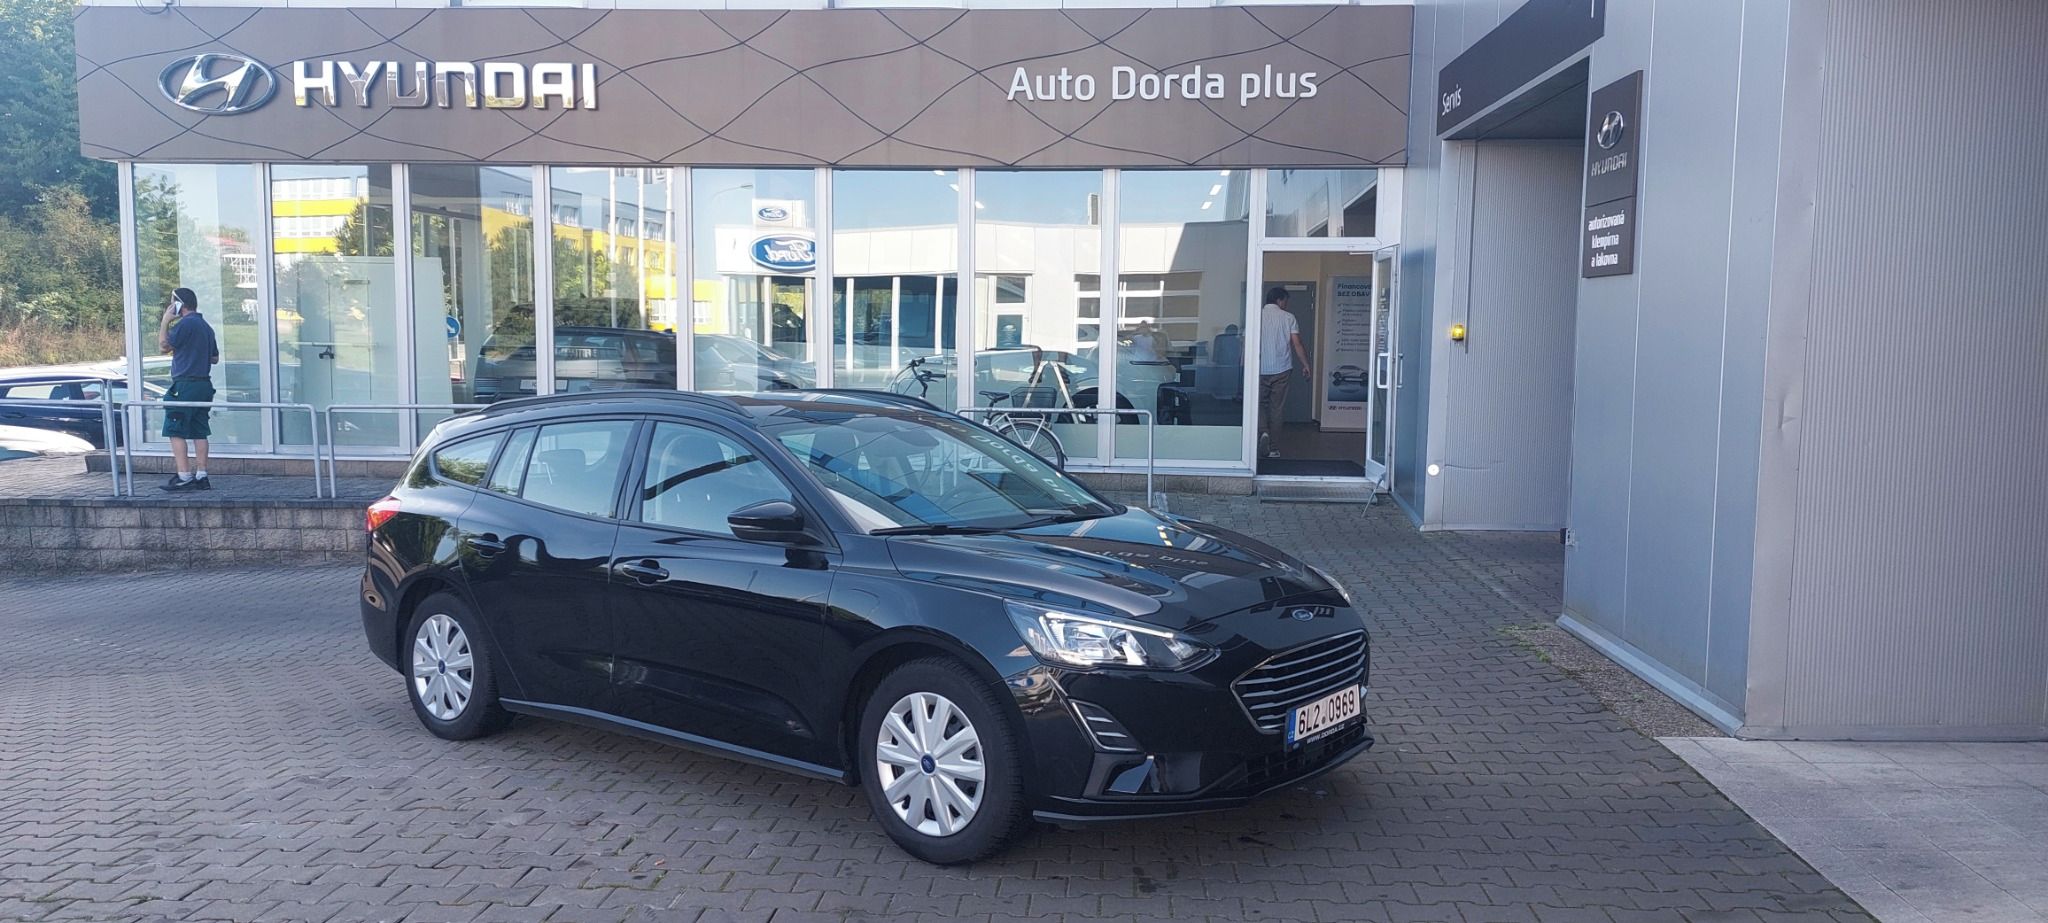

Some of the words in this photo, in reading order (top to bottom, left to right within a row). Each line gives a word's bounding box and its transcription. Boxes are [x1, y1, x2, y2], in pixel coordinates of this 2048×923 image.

[293, 61, 598, 108] HYUNDAI
[1007, 67, 1095, 101] Auto
[1112, 65, 1225, 100] Dorda
[1240, 64, 1317, 107] plus
[1442, 84, 1462, 116] Servis
[1591, 152, 1628, 177] HYUNDAI
[1588, 209, 1625, 231] autorizovaná
[1591, 231, 1620, 250] klempírna
[1591, 257, 1596, 267] a
[1596, 252, 1618, 267] lakovna
[1299, 705, 1320, 734] 6L2
[1329, 690, 1354, 722] 0969
